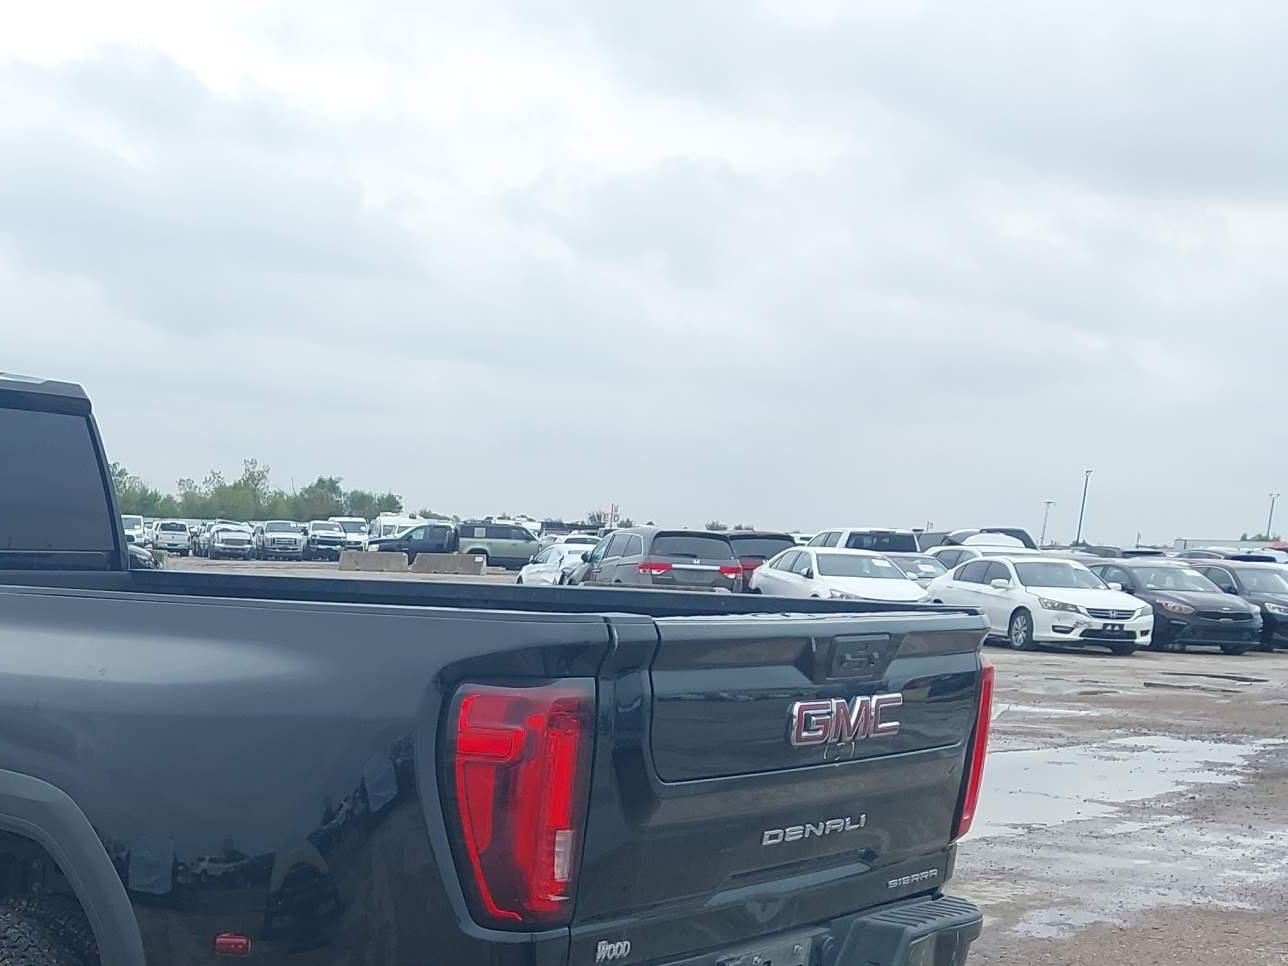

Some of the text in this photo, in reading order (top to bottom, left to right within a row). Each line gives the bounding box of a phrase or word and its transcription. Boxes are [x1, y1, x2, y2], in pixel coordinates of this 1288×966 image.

[791, 693, 903, 746] GMC
[762, 813, 867, 846] DENALI
[887, 868, 939, 889] SIERRA
